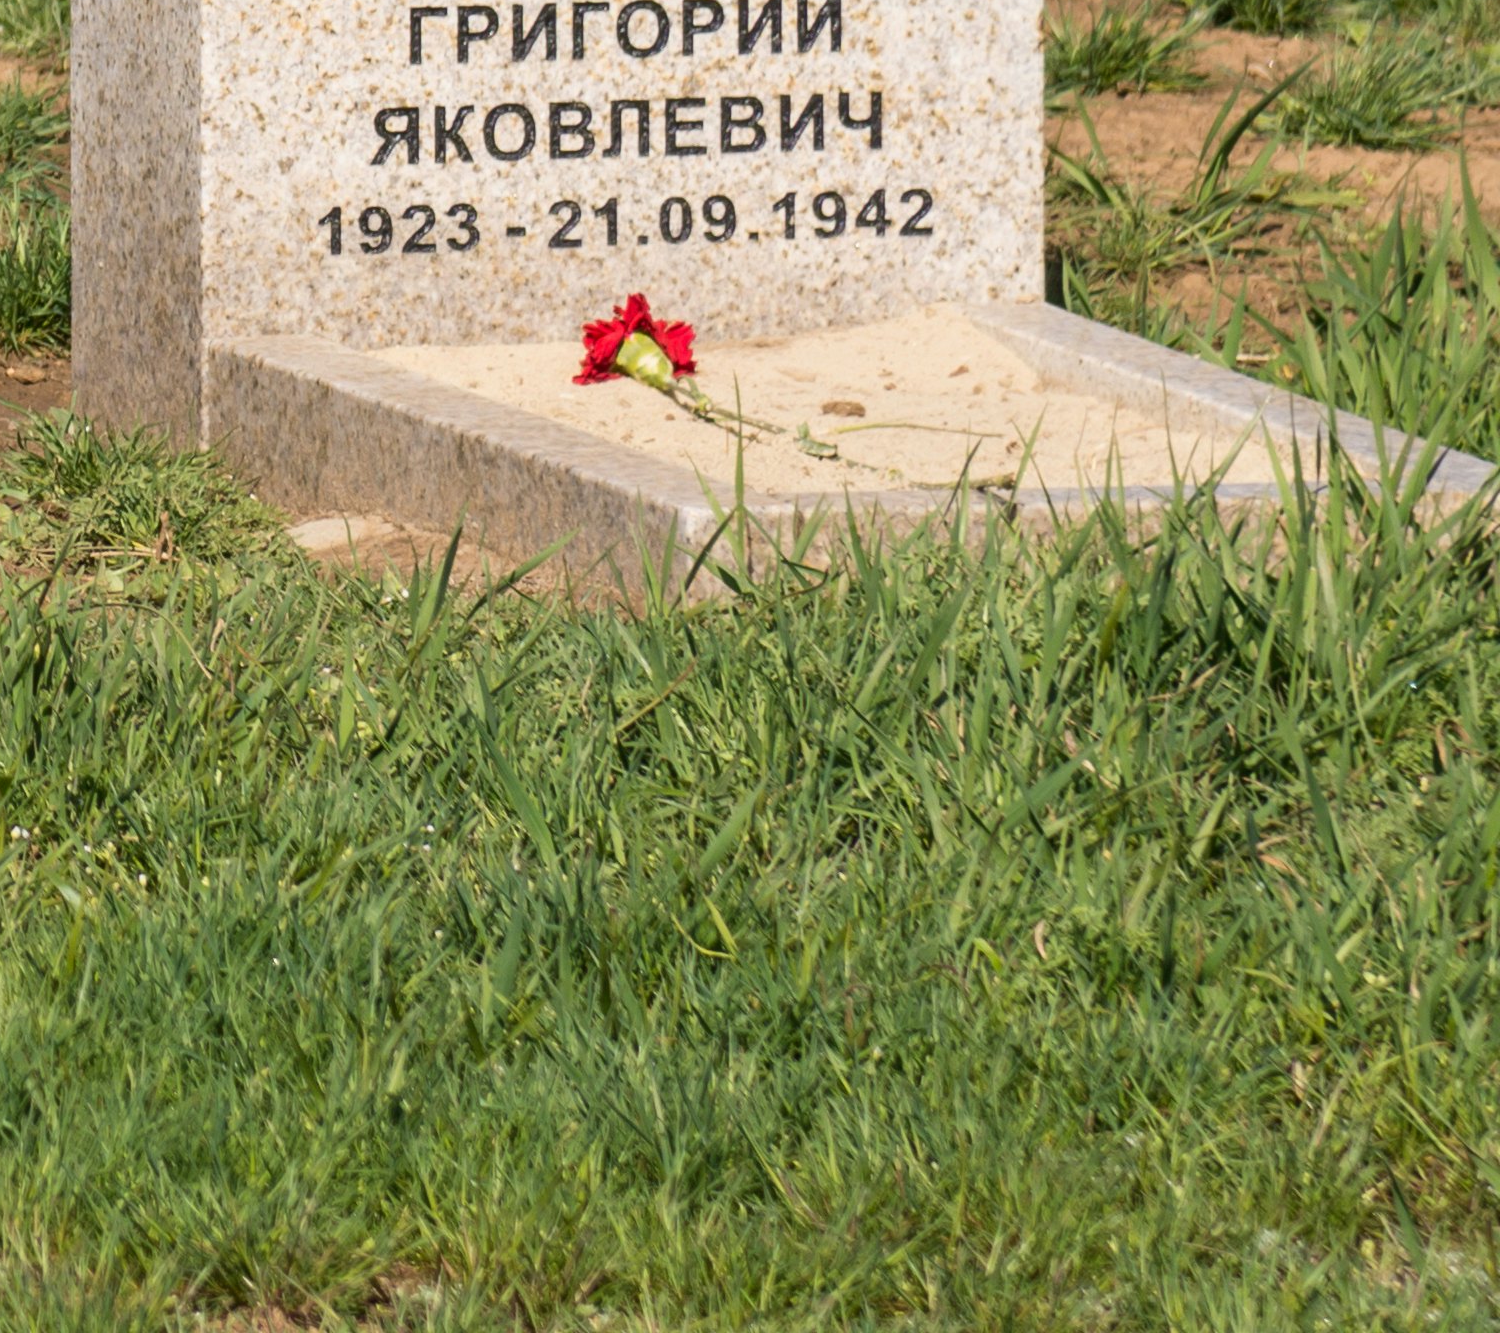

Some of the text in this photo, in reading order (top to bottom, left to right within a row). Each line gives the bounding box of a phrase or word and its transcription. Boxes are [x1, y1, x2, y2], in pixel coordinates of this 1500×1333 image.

[371, 91, 884, 165] ЯКОВЛЕВИЧ
[318, 203, 481, 255] 1923
[548, 188, 935, 249] 21.09.1942
